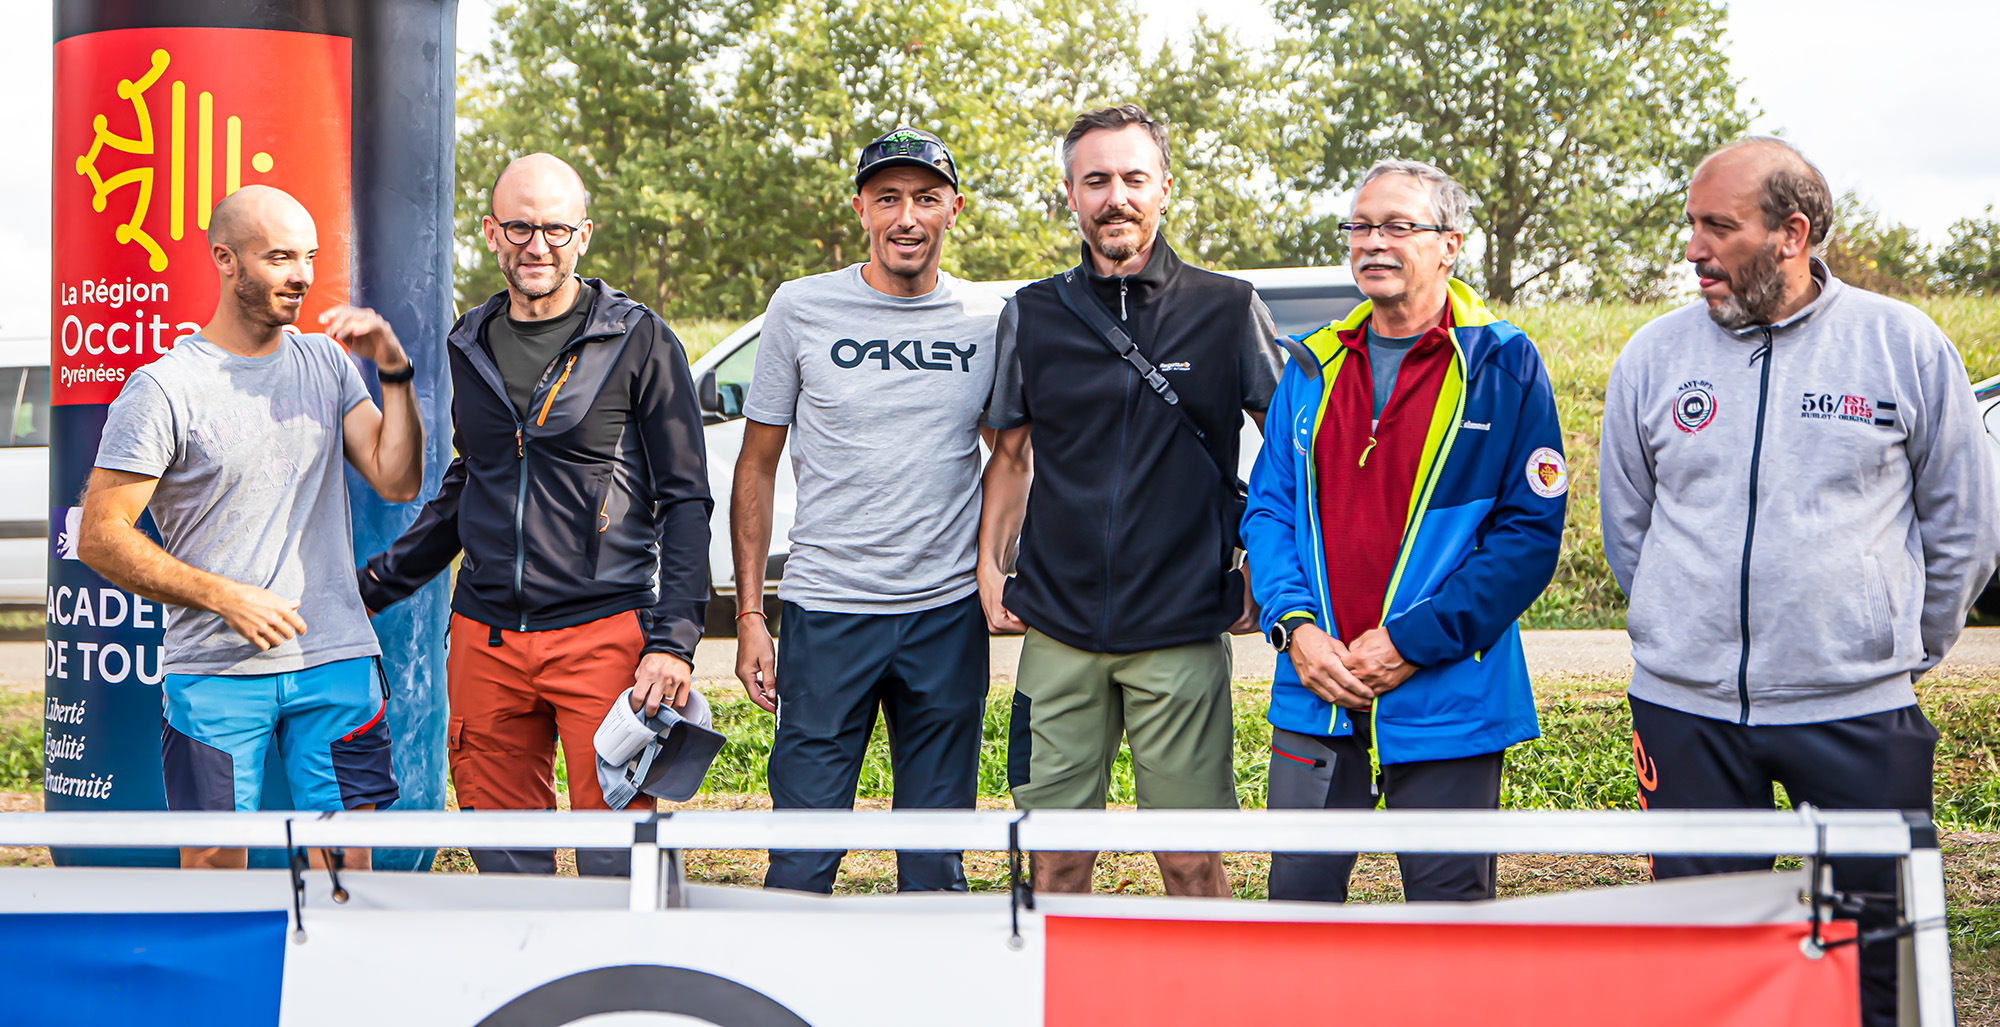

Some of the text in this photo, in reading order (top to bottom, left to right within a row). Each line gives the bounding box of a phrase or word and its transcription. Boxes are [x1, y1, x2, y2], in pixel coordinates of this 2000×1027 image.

[61, 277, 168, 308] La Région
[61, 310, 302, 357] Occita
[831, 338, 977, 373] OAKLEY
[61, 363, 125, 388] Pyrénées
[1838, 414, 1872, 425] ORIGINAL
[1844, 405, 1873, 418] 1925
[46, 585, 168, 628] ACADE
[46, 639, 68, 679] DE
[46, 696, 86, 725] Liberté
[45, 728, 86, 762] Égalité
[45, 767, 114, 800] Fraternité
